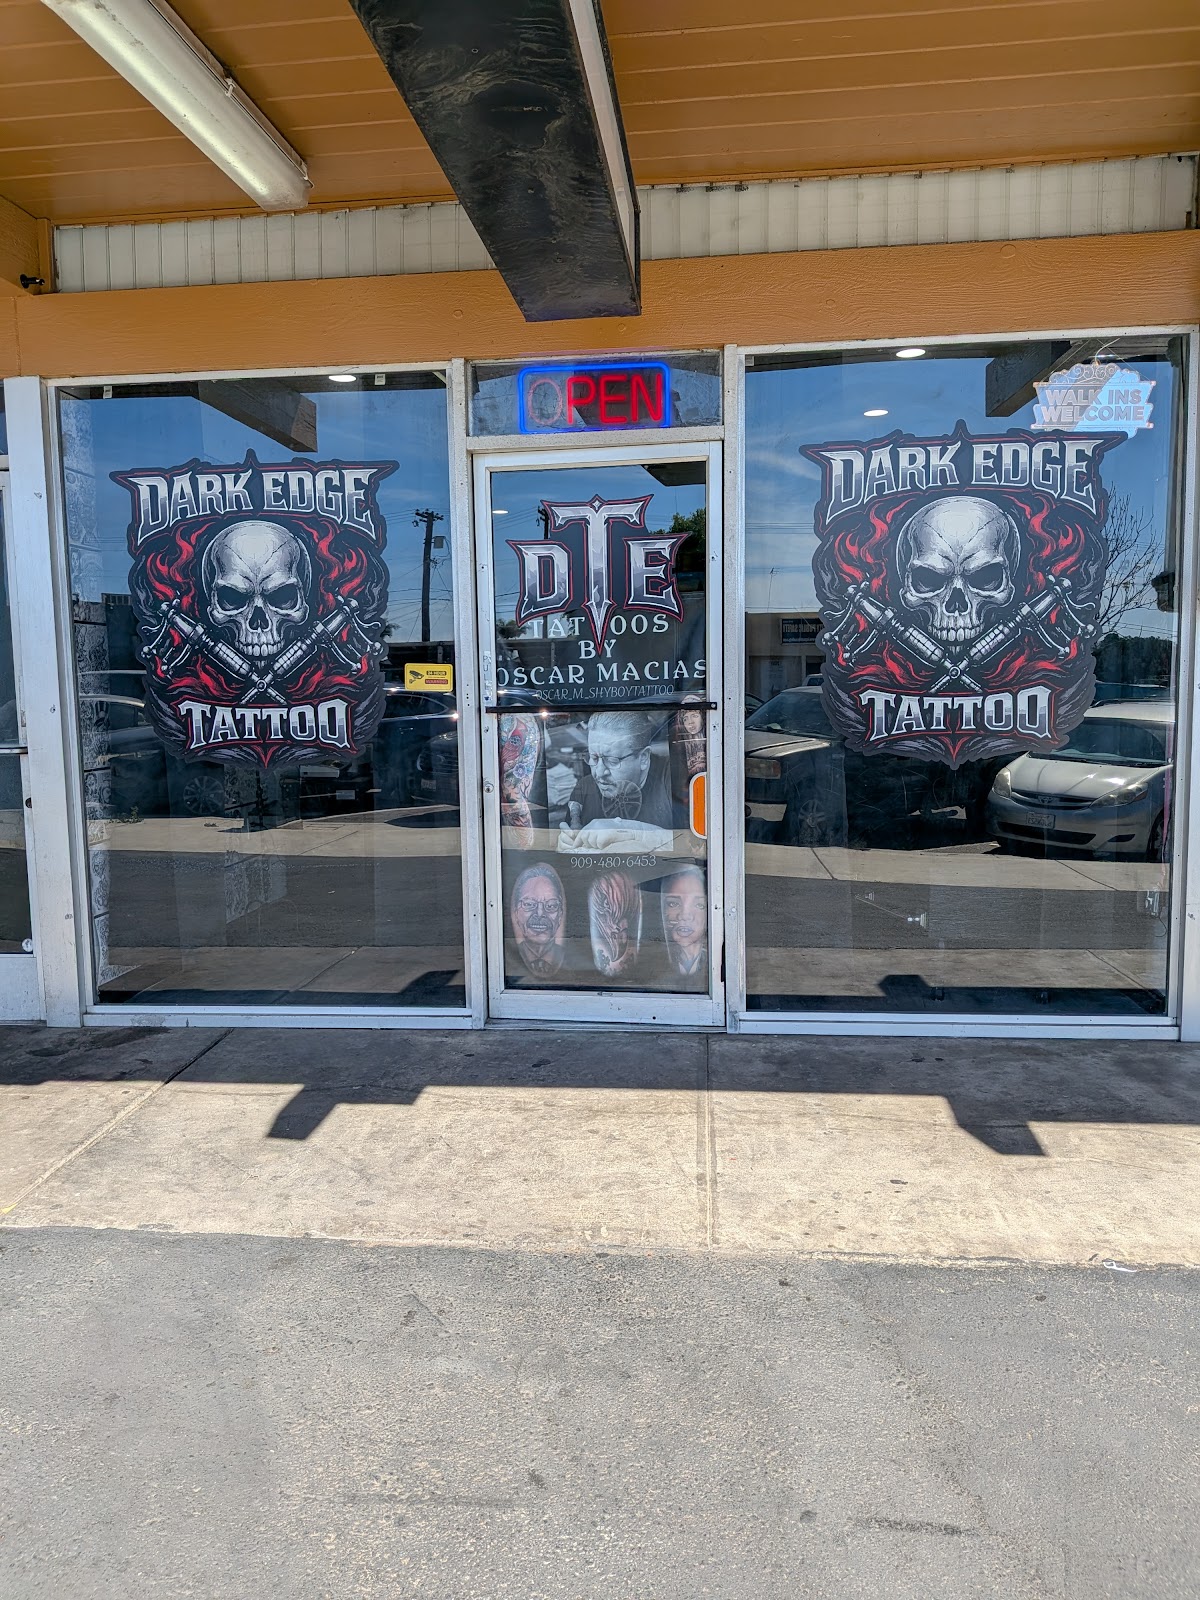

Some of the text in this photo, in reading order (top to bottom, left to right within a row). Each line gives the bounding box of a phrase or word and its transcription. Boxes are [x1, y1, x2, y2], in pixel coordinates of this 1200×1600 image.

[527, 373, 664, 426] OPEN
[1040, 405, 1145, 423] WELCOME
[1045, 388, 1143, 406] WALK INS
[818, 439, 1104, 526] DARK EDGE
[127, 468, 379, 547] DARK EDGE
[528, 613, 670, 638] TATOOS
[577, 638, 617, 660] BY
[496, 659, 707, 687] OSCAR MACIAS
[179, 697, 352, 750] TATTOO
[857, 685, 1052, 742] TATTOO
